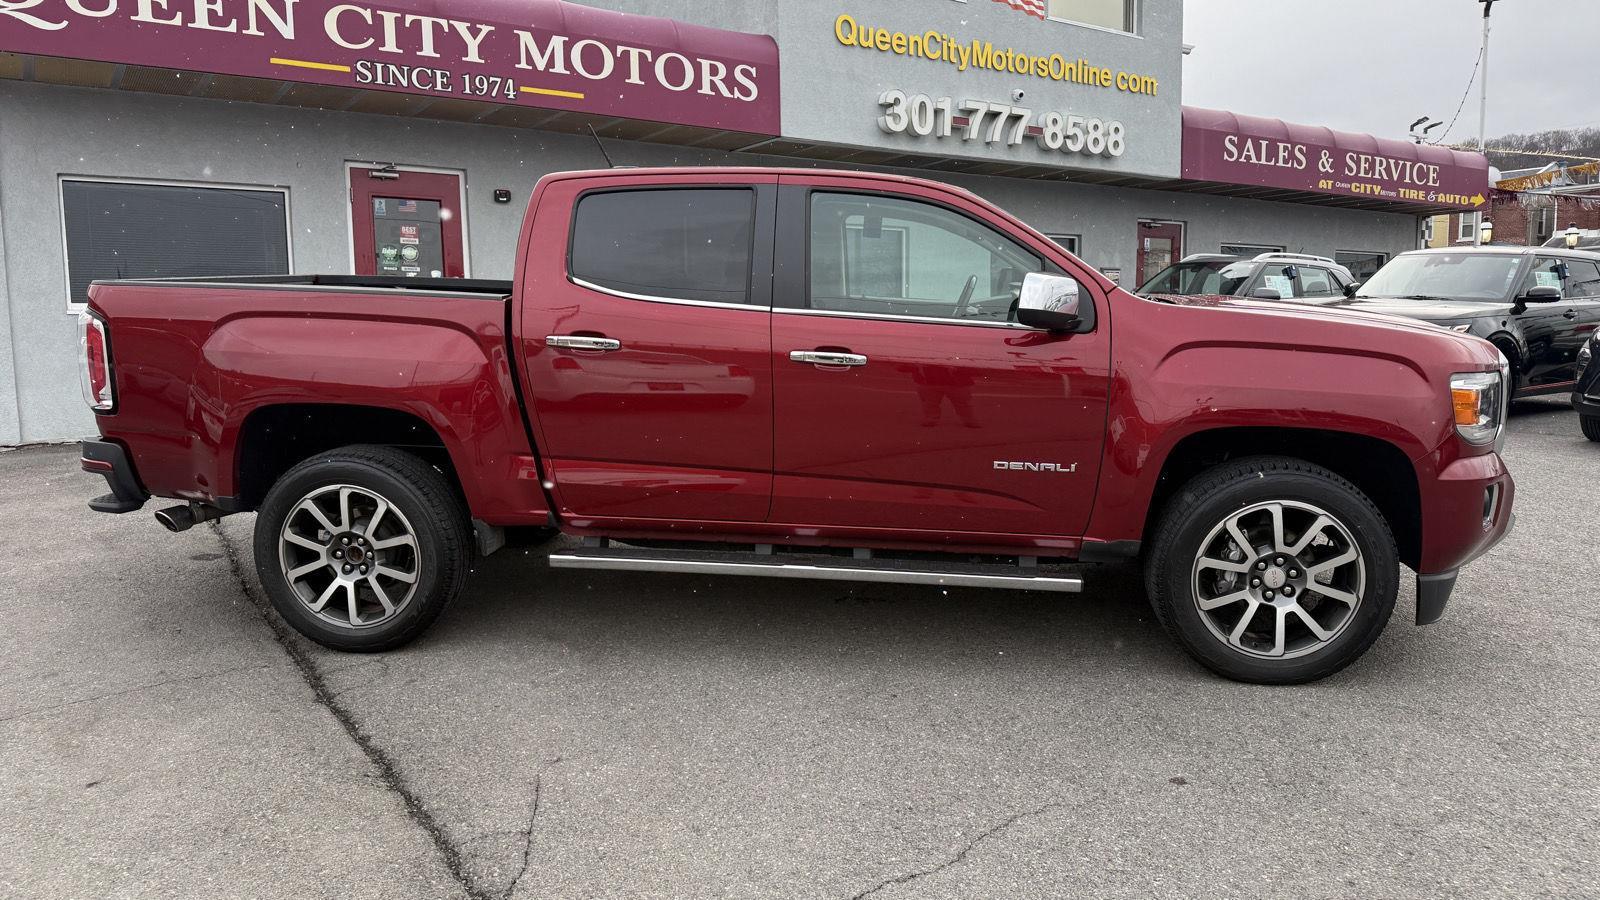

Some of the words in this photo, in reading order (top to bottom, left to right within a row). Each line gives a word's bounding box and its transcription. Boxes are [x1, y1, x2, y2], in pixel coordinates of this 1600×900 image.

[323, 4, 495, 63] CITY
[514, 29, 759, 102] MOTORS
[355, 60, 452, 92] SINCE
[462, 73, 517, 99] 1974
[877, 88, 1126, 157] 301-777-8588
[1223, 134, 1307, 170] SALES
[1318, 149, 1335, 173] &
[1344, 152, 1440, 187] SERVICE
[1318, 179, 1334, 190] AT
[1351, 182, 1382, 196] CITY
[1398, 187, 1426, 201] TIRE
[1427, 191, 1439, 202] &
[1438, 194, 1469, 205] AUTO
[993, 460, 1078, 472] DENALI
